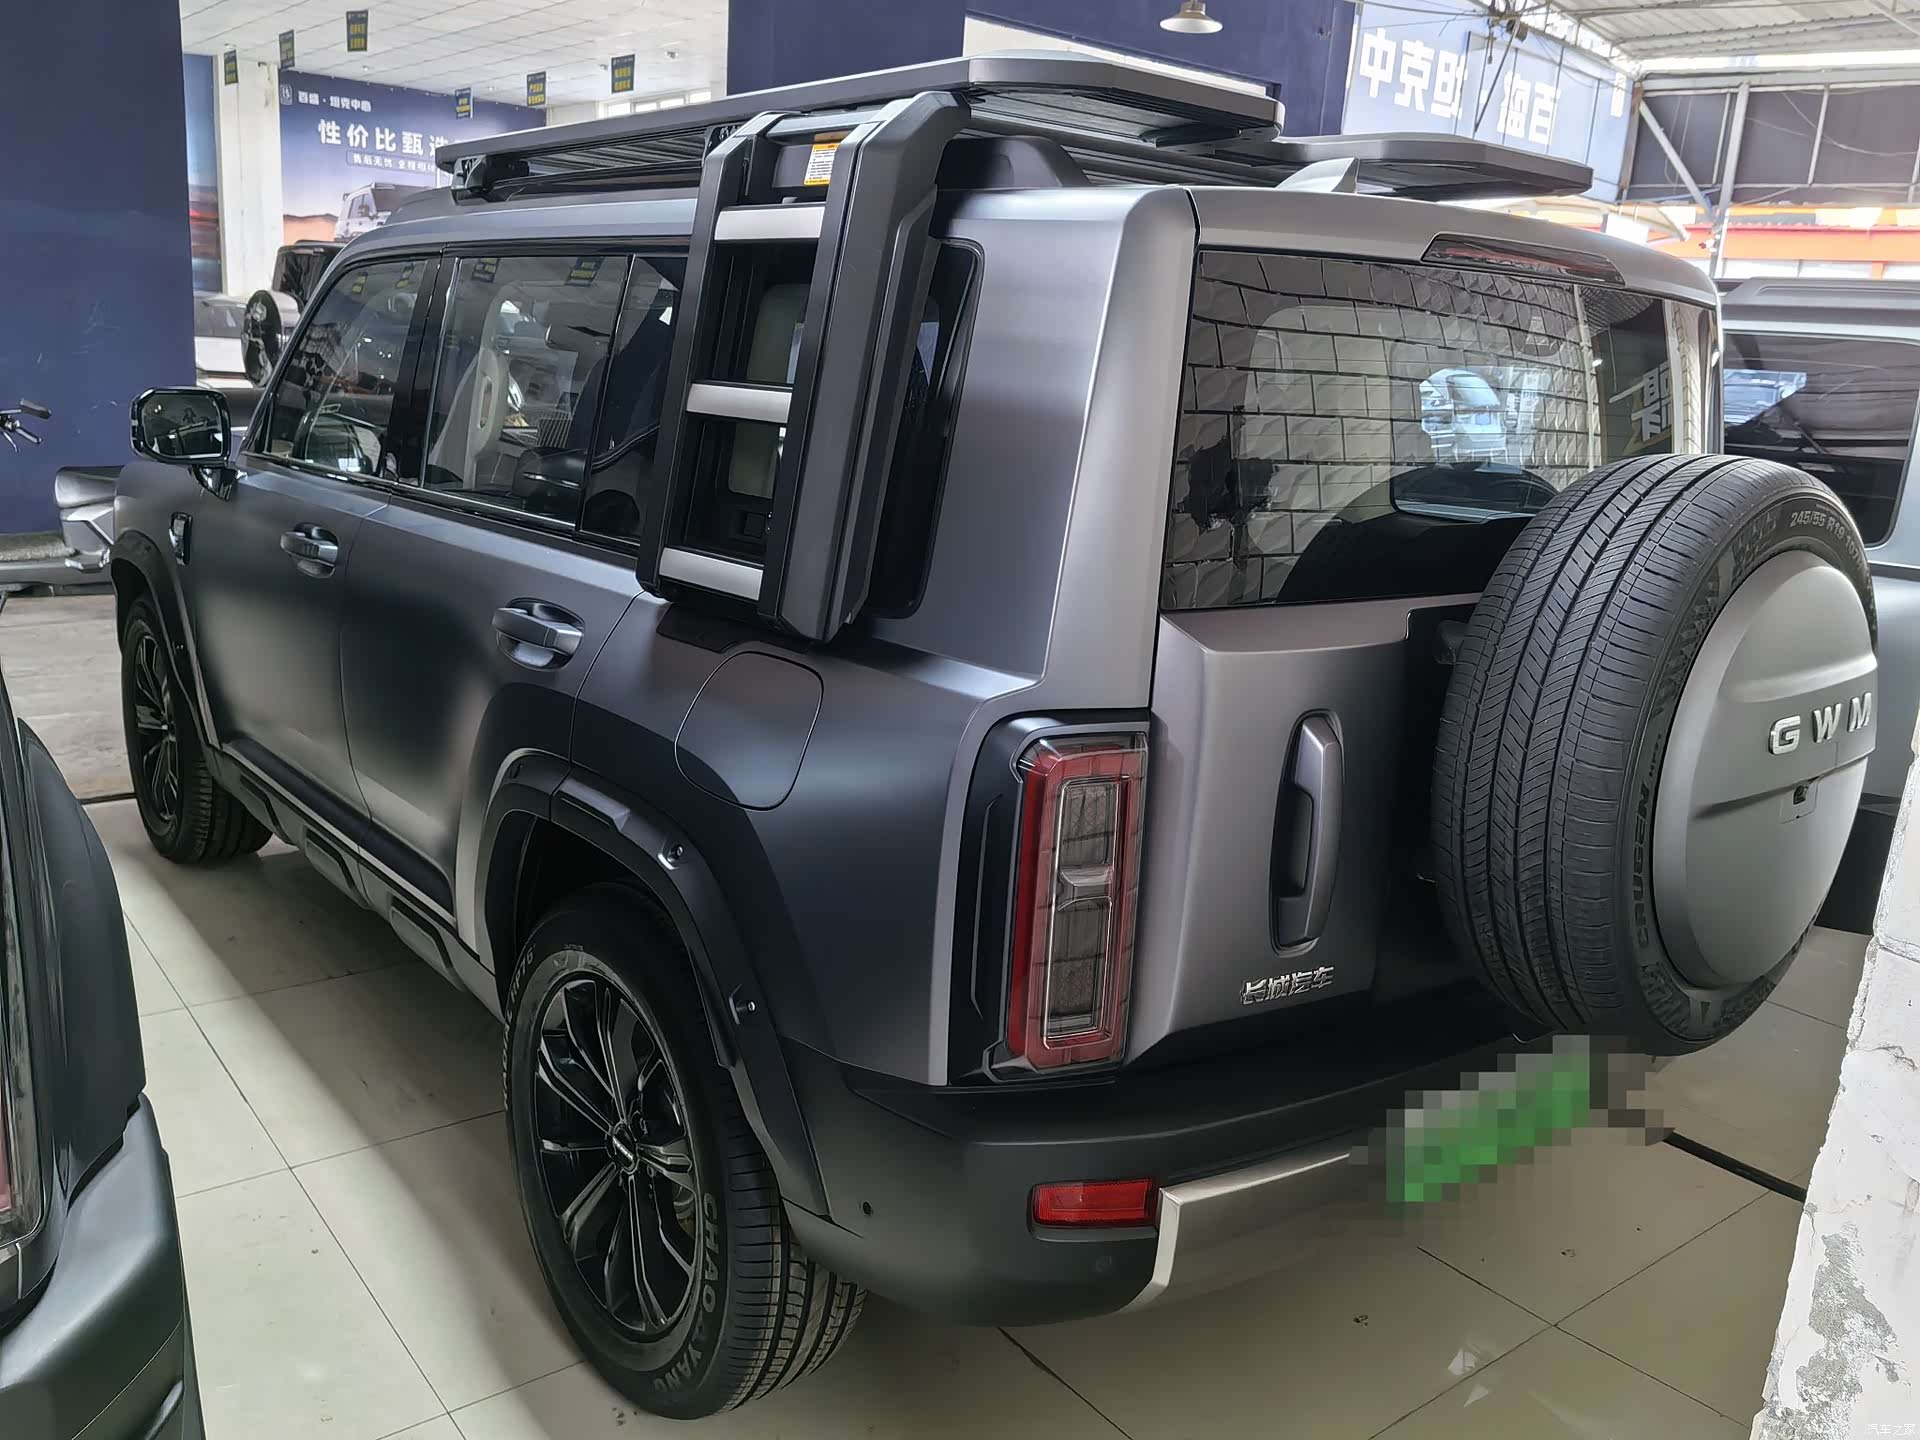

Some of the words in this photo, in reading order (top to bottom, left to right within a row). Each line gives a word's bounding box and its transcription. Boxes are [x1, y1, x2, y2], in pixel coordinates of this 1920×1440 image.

[1790, 510, 1826, 528] 245/55
[1768, 691, 1873, 756] GWM
[1241, 966, 1335, 1005] 长城汽车
[702, 1192, 720, 1314] CHAO
